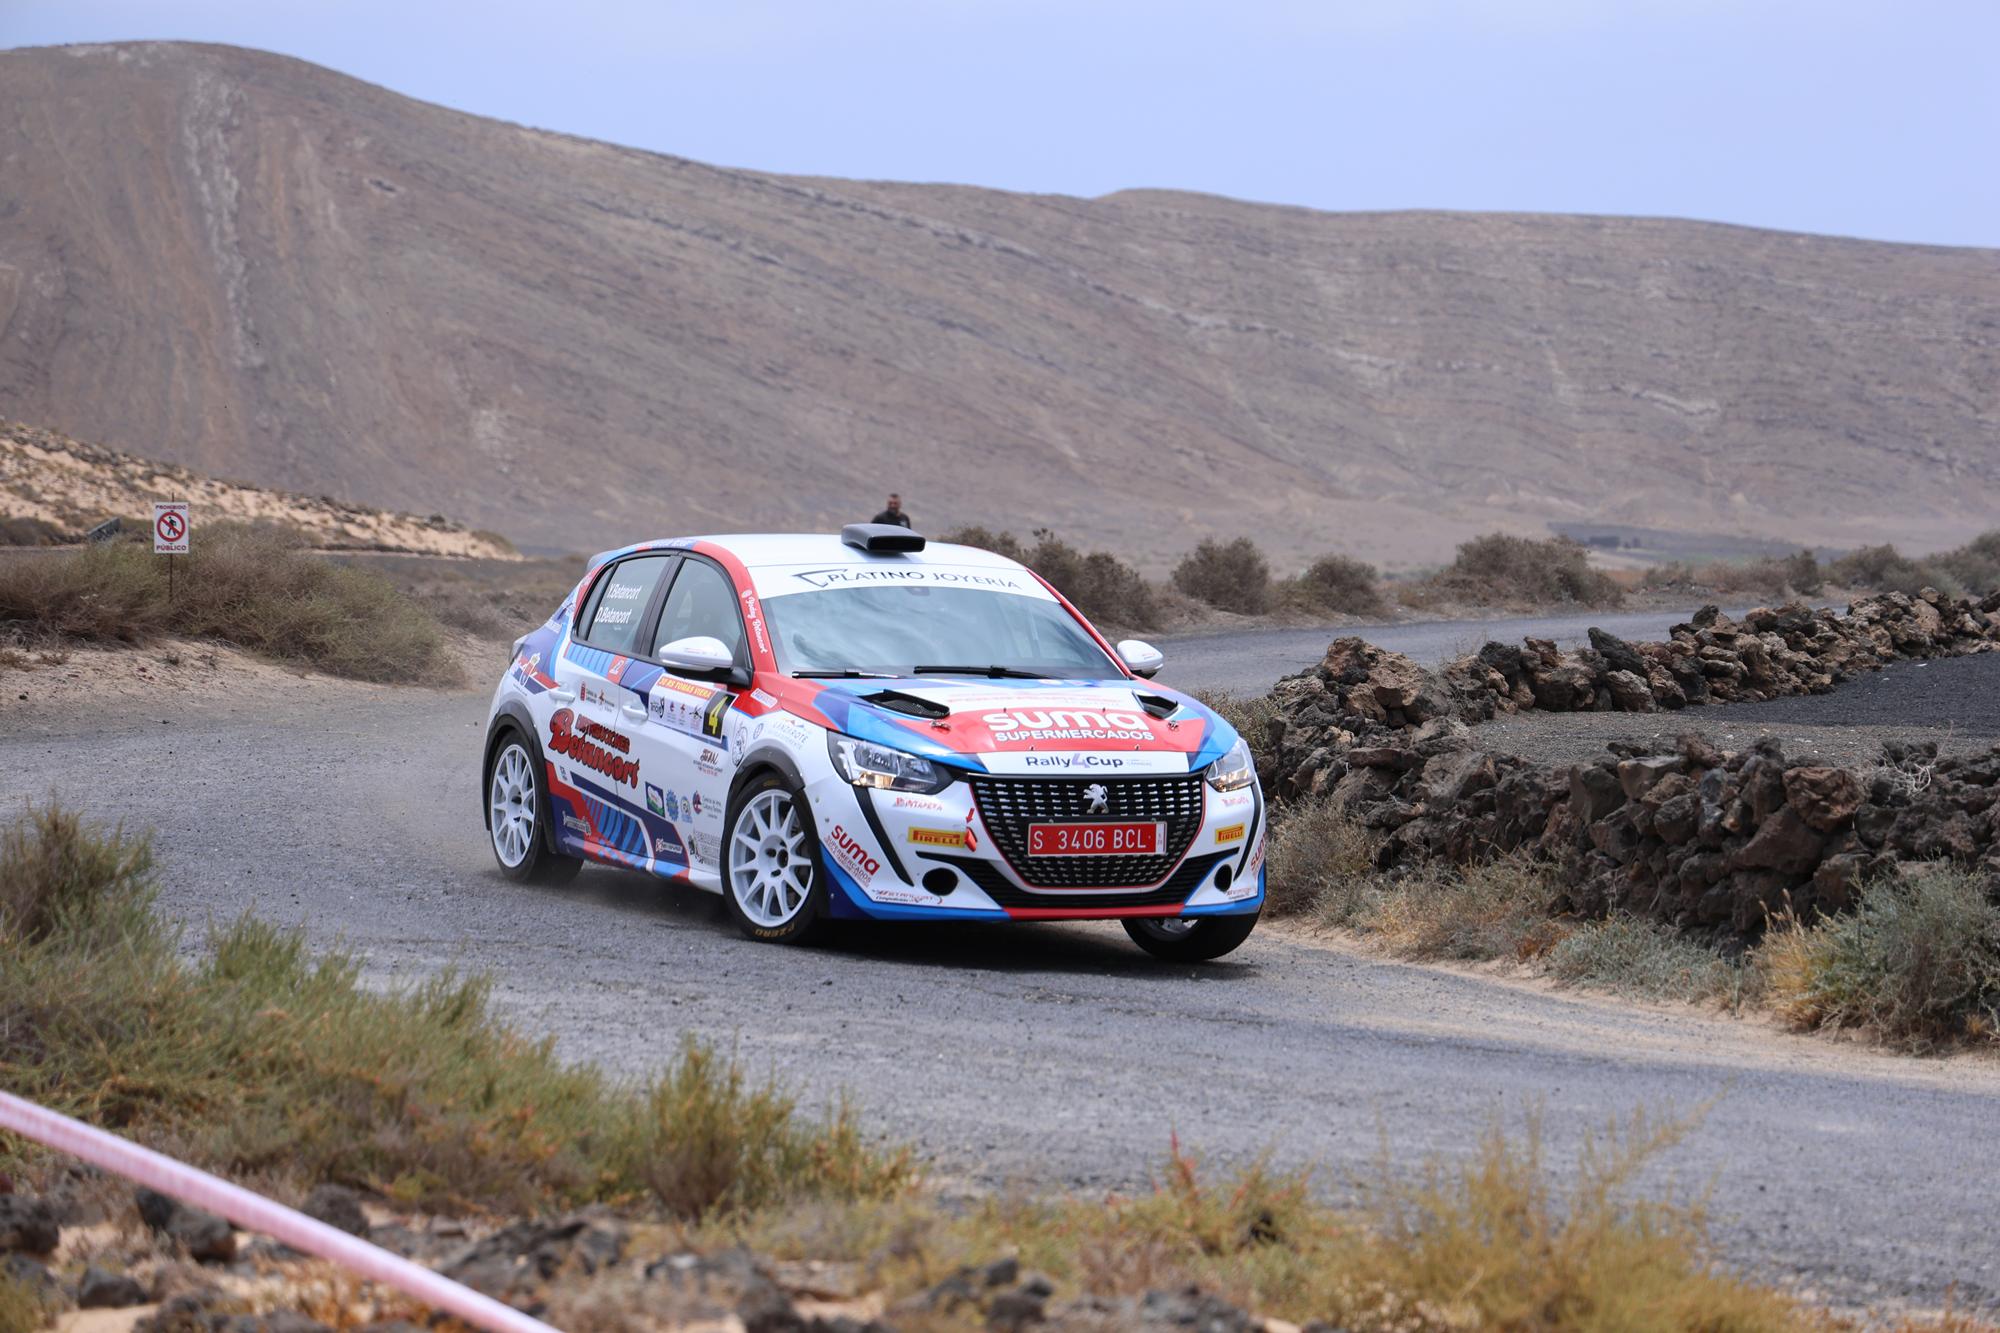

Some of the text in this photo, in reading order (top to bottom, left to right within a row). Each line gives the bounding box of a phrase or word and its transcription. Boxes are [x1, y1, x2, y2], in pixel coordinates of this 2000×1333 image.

[828, 571, 925, 582] PLATINO
[607, 584, 642, 600] Y.Betancort
[595, 607, 632, 624] D.Betancort
[708, 695, 727, 735] 4
[982, 710, 1149, 731] suma
[994, 729, 1155, 742] SUPERMERCADOS
[548, 708, 640, 789] Betancort
[912, 830, 961, 846] PIRELLI
[1033, 830, 1043, 849] S
[1057, 829, 1105, 849] 3406
[1113, 829, 1146, 849] BCL
[1217, 827, 1243, 841] PIRELLI
[831, 825, 880, 876] suma
